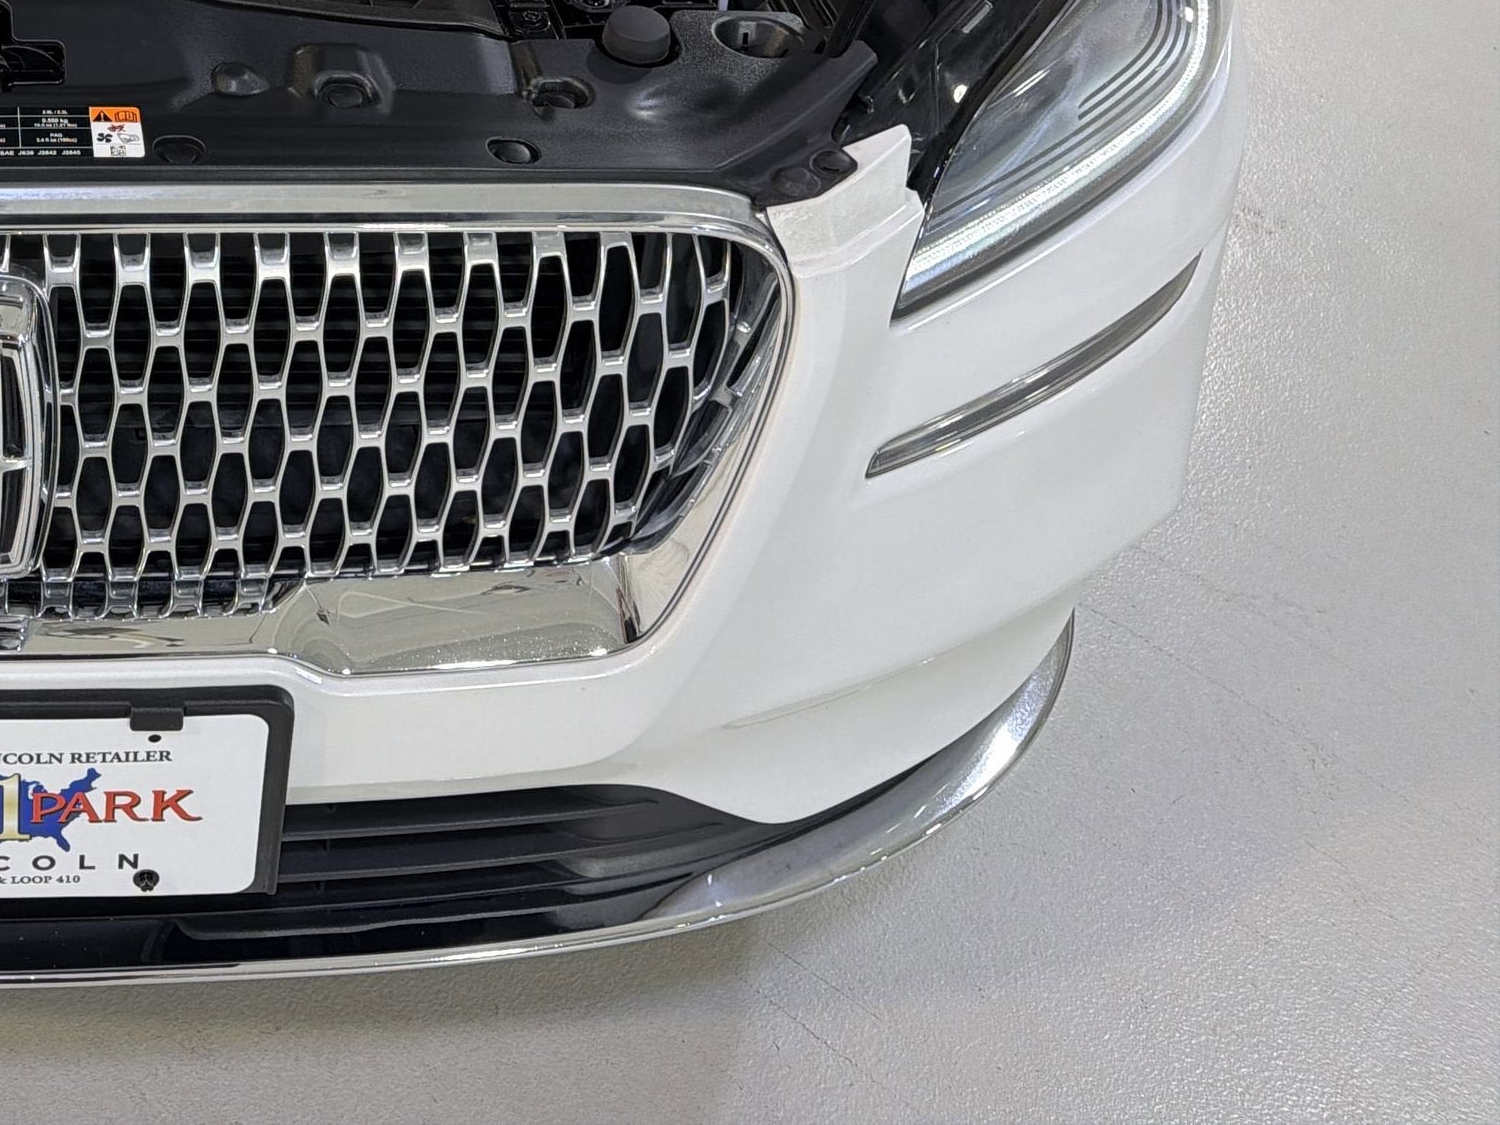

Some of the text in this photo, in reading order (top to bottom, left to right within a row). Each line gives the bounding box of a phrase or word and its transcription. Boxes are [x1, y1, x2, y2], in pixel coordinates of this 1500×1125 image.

[69, 750, 173, 764] RETAILER
[31, 789, 204, 823] PARK
[10, 876, 53, 885] LOOP
[56, 875, 81, 884] 410
